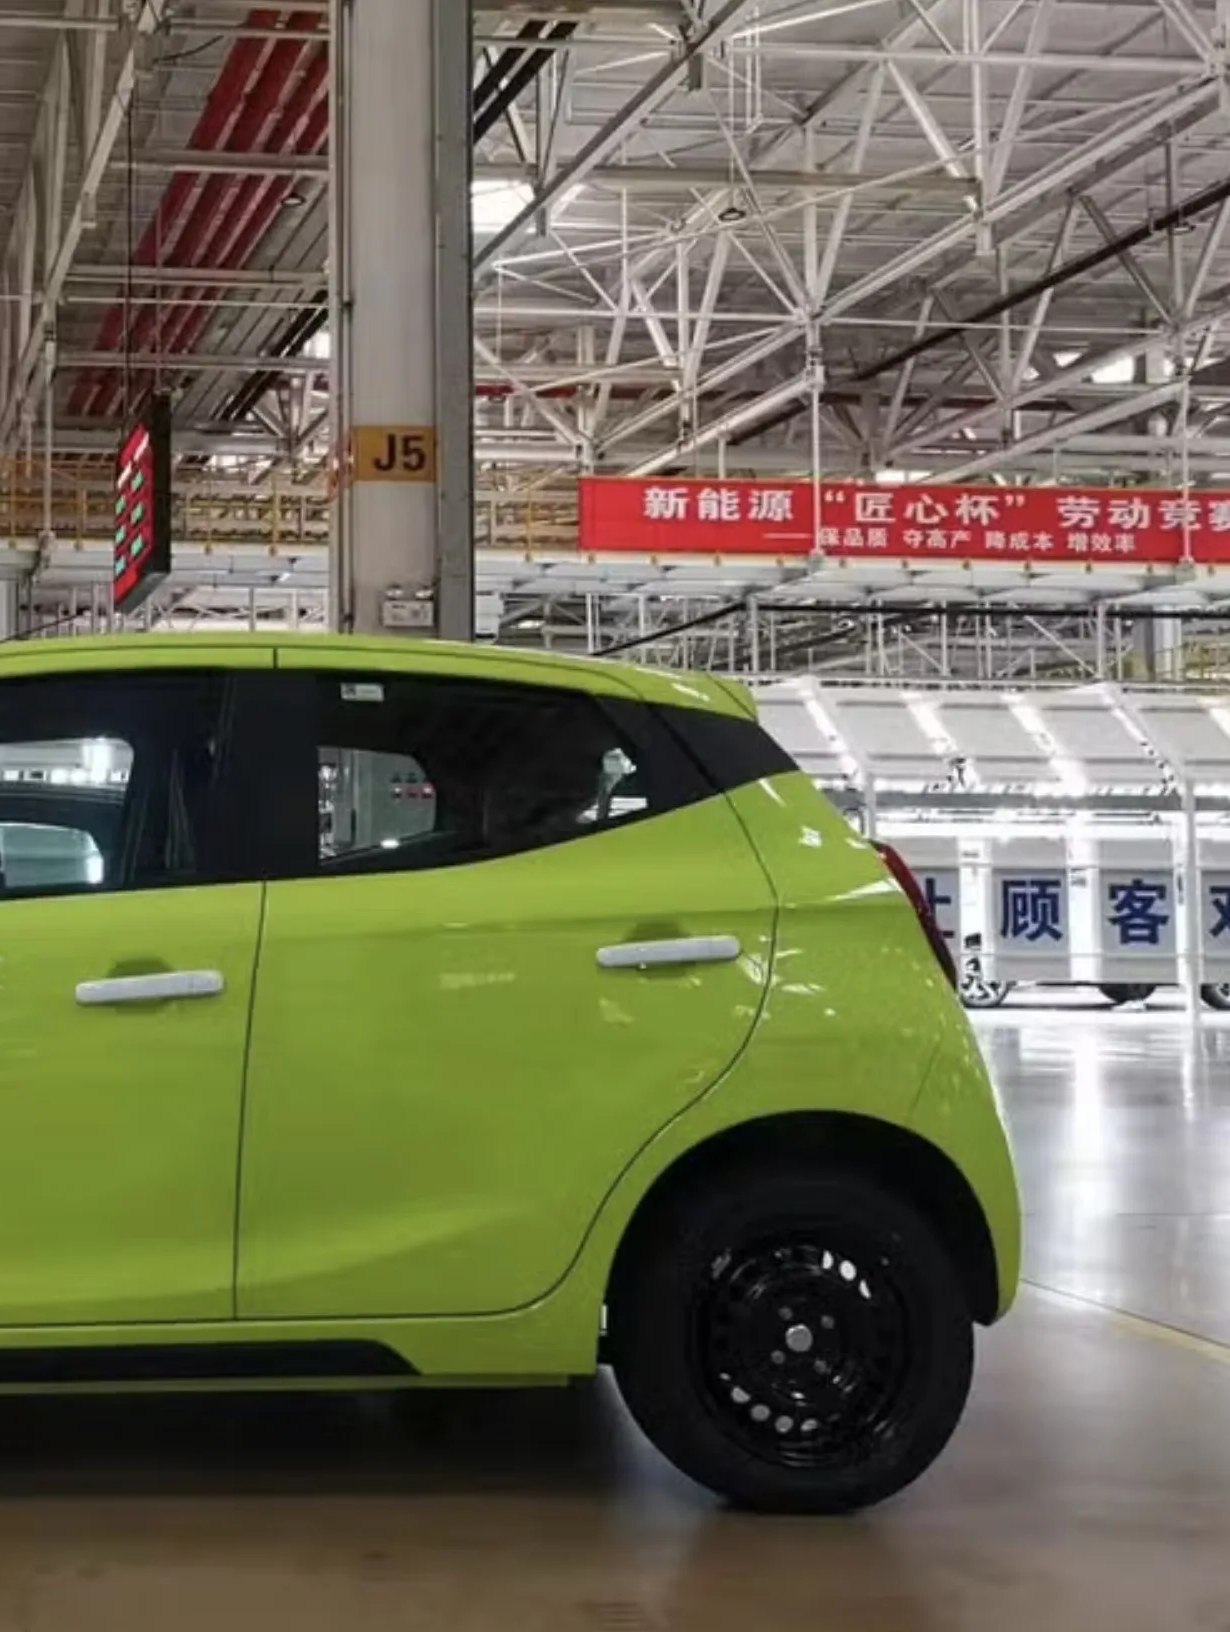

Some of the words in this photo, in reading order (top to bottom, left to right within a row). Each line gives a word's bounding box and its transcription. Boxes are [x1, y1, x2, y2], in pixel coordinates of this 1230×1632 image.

[372, 434, 426, 472] J5
[903, 529, 972, 549] 夺高产
[985, 531, 1054, 551] 降成本
[1067, 533, 1136, 553] 增效率
